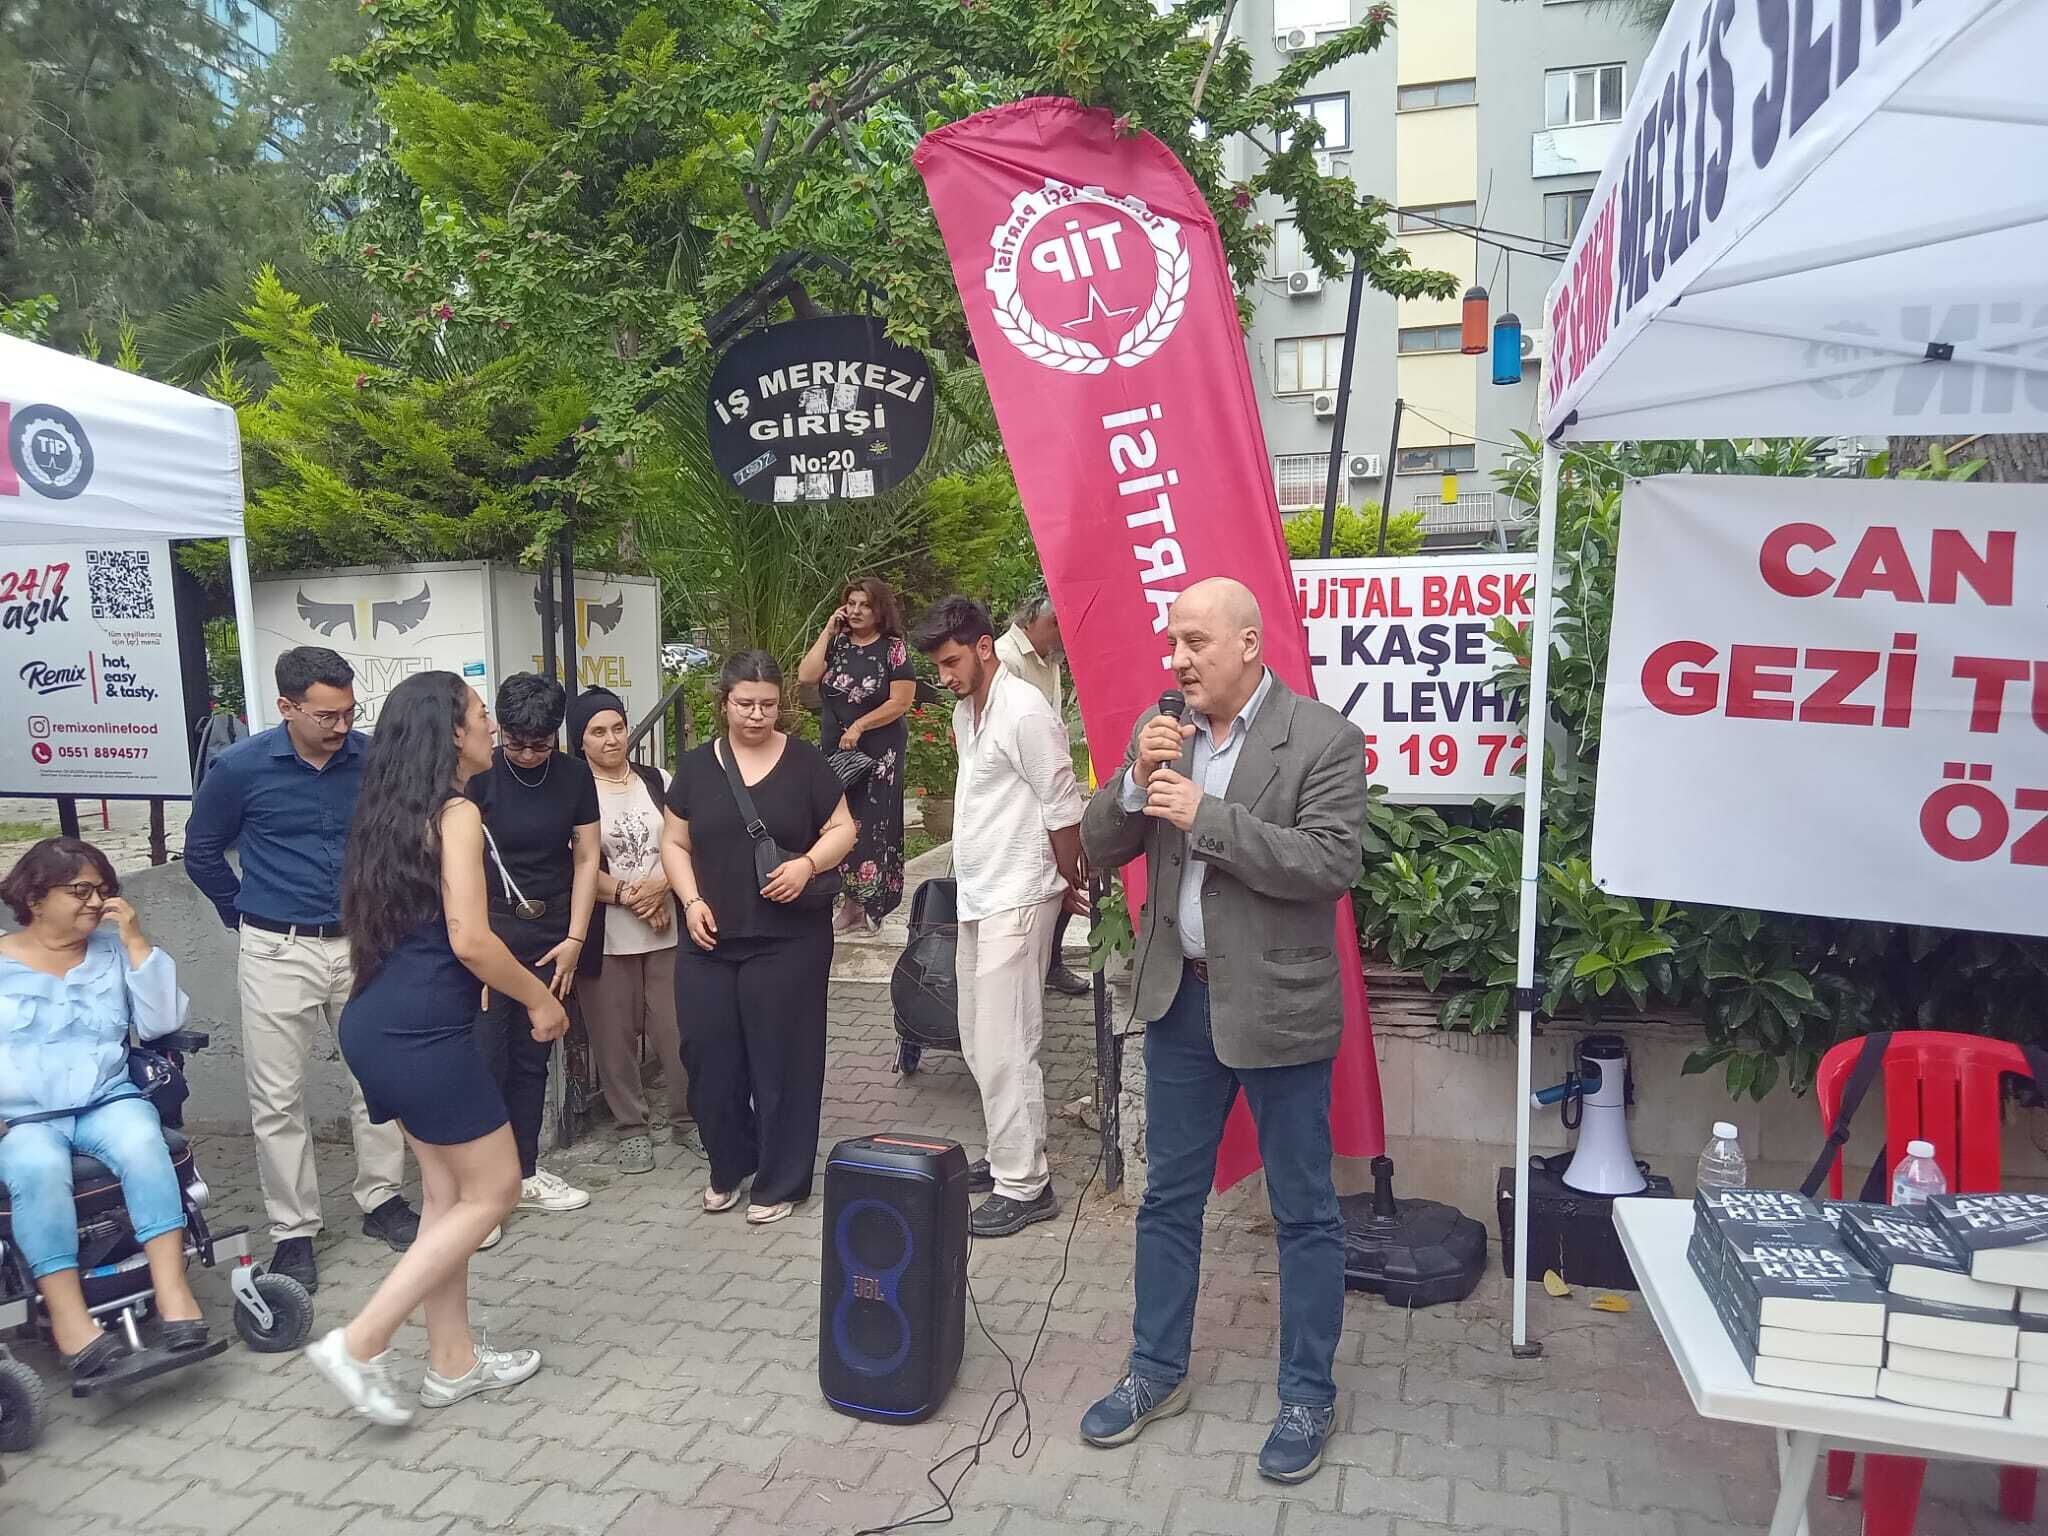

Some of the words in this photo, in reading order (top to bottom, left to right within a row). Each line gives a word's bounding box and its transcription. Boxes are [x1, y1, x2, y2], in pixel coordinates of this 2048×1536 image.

[1614, 0, 1735, 328] MECLİS
[714, 388, 750, 425] İŞ
[758, 360, 927, 403] MERKEZİ
[749, 403, 886, 440] GİRİŞİ
[37, 435, 67, 456] TİP
[790, 450, 856, 475] No:20
[0, 562, 70, 603] 24/7
[1759, 522, 2017, 606] CAN
[3, 586, 69, 635] açık
[1299, 577, 1412, 619] İJİTAL
[1422, 573, 1536, 618] BASK
[1341, 623, 1486, 677] KAŞE
[20, 661, 87, 690] Remix
[102, 653, 130, 670] hot,
[104, 672, 136, 687] easy
[1641, 632, 1918, 728] GEZİ
[1952, 655, 2048, 735] T
[106, 683, 118, 698] &
[120, 685, 158, 702] tasty.
[52, 721, 159, 735] remixonlinefood
[58, 746, 88, 758] 0551
[94, 747, 149, 759] 8894577
[1364, 735, 1379, 776] 5
[1399, 734, 1458, 776] 19
